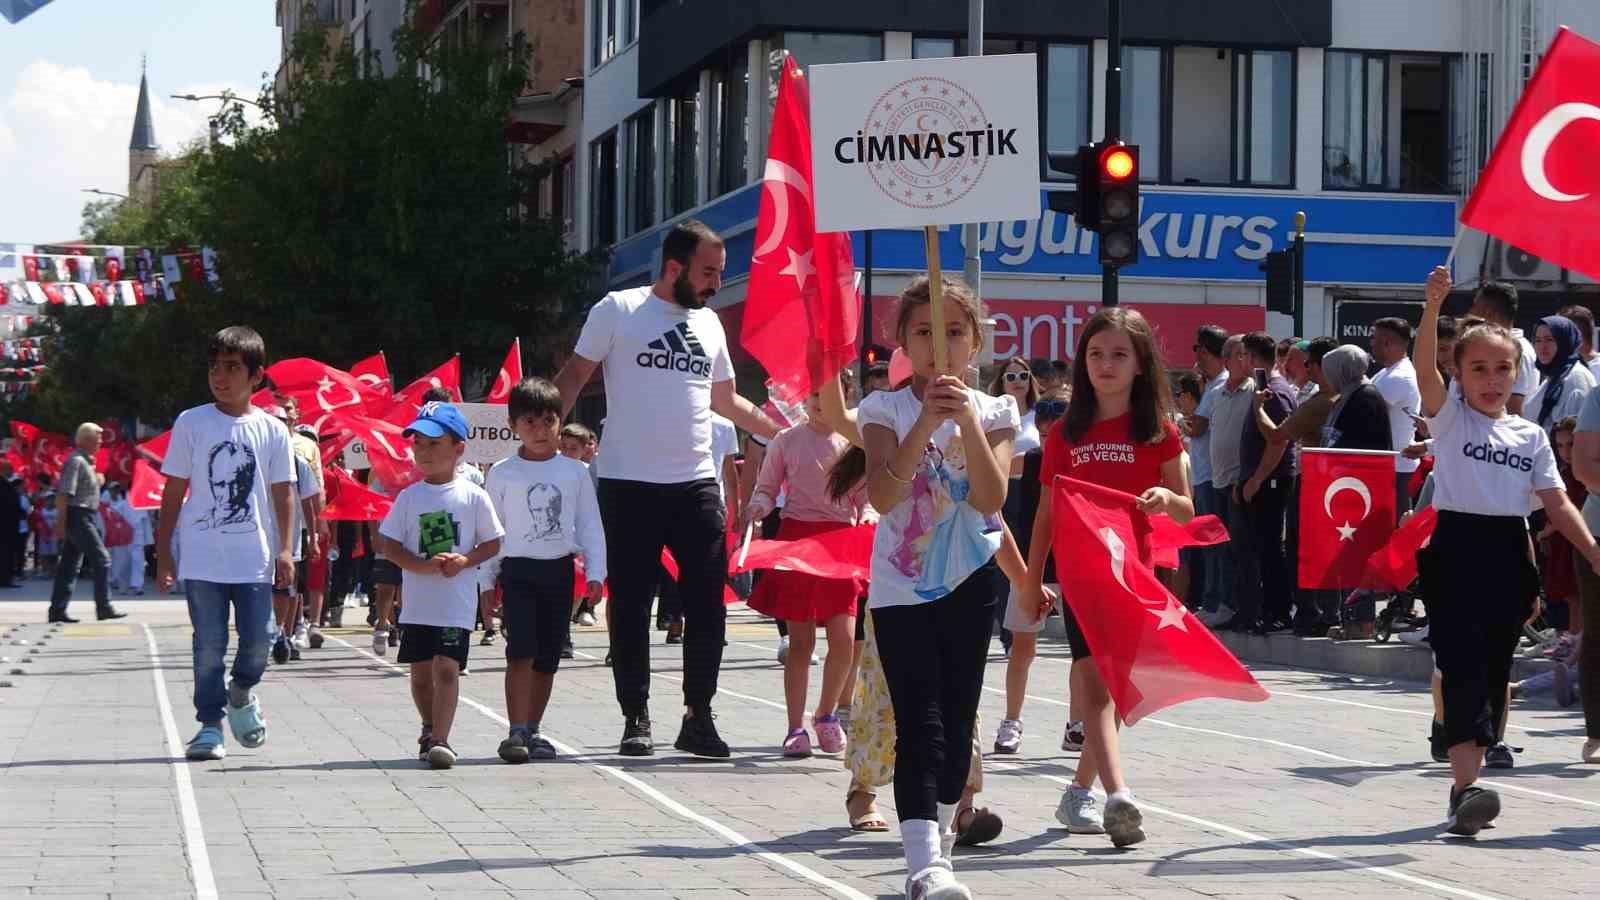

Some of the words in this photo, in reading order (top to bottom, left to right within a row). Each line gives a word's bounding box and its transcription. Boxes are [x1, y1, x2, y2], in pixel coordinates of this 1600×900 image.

[834, 123, 1019, 164] CİMNASTİK
[636, 350, 712, 378] adidas
[467, 426, 520, 441] UTBOL
[1072, 451, 1091, 468] LAS
[1093, 449, 1136, 464] VEGAS
